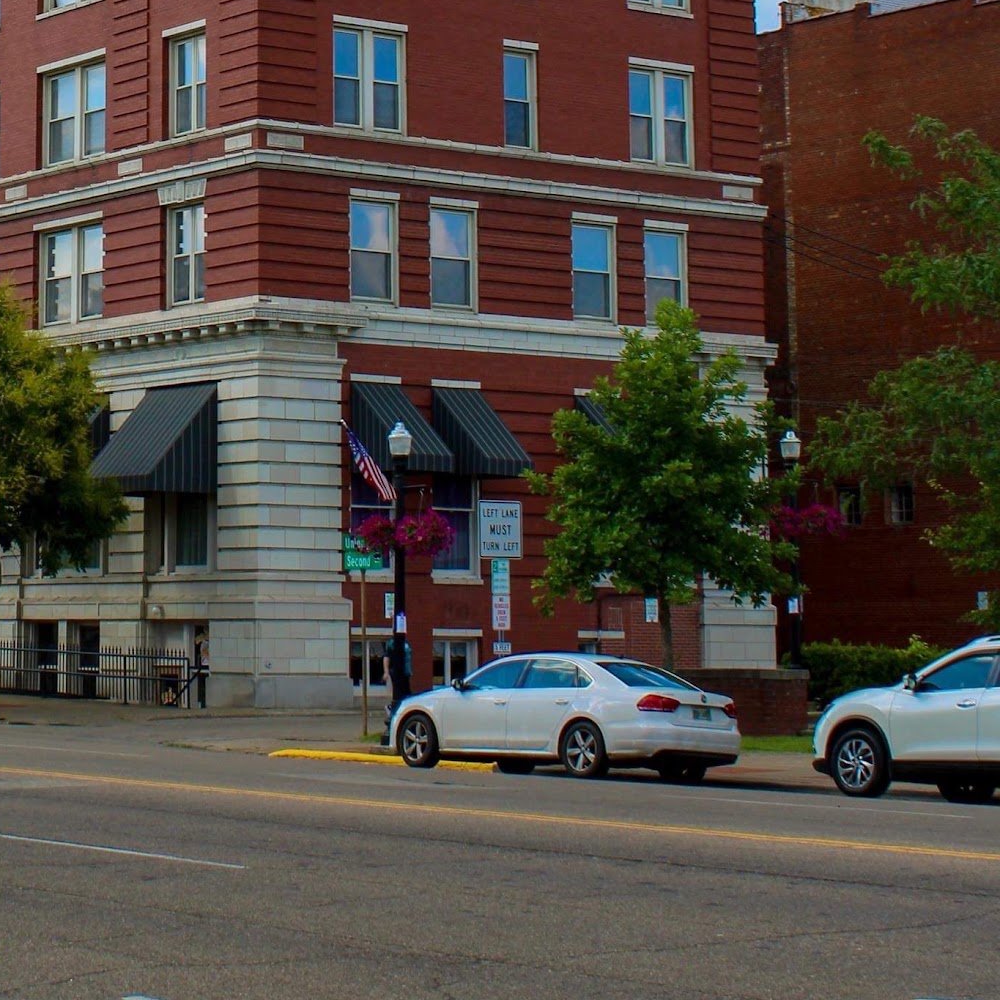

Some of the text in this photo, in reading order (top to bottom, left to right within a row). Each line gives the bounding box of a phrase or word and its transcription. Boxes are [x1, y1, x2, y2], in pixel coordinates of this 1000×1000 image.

[483, 509, 518, 518] LEFT LANE
[490, 524, 511, 535] MUST
[483, 541, 518, 551] TURN LEFT
[347, 555, 370, 567] Second
